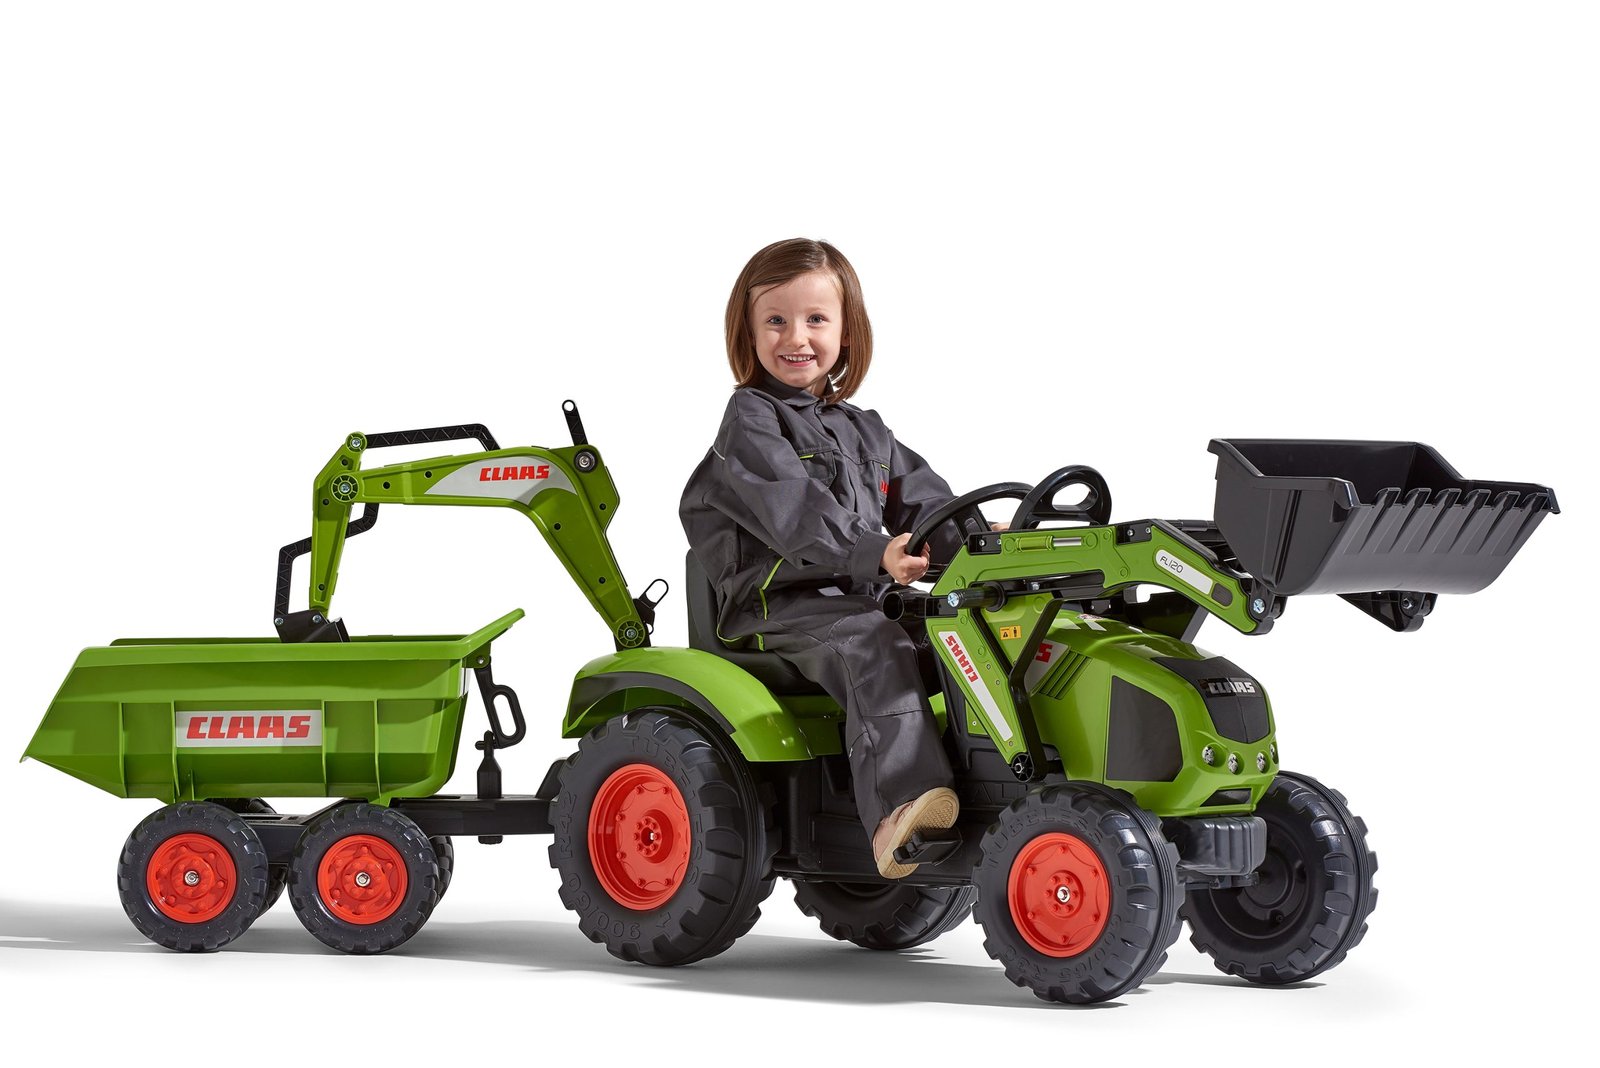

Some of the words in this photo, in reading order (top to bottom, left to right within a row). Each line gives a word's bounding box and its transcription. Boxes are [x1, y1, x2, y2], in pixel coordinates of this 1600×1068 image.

[479, 465, 550, 482] CLAAS
[1159, 555, 1184, 574] FL120
[944, 635, 979, 683] CLAAS
[1207, 681, 1256, 694] CLAAS
[186, 715, 311, 739] CLAAS
